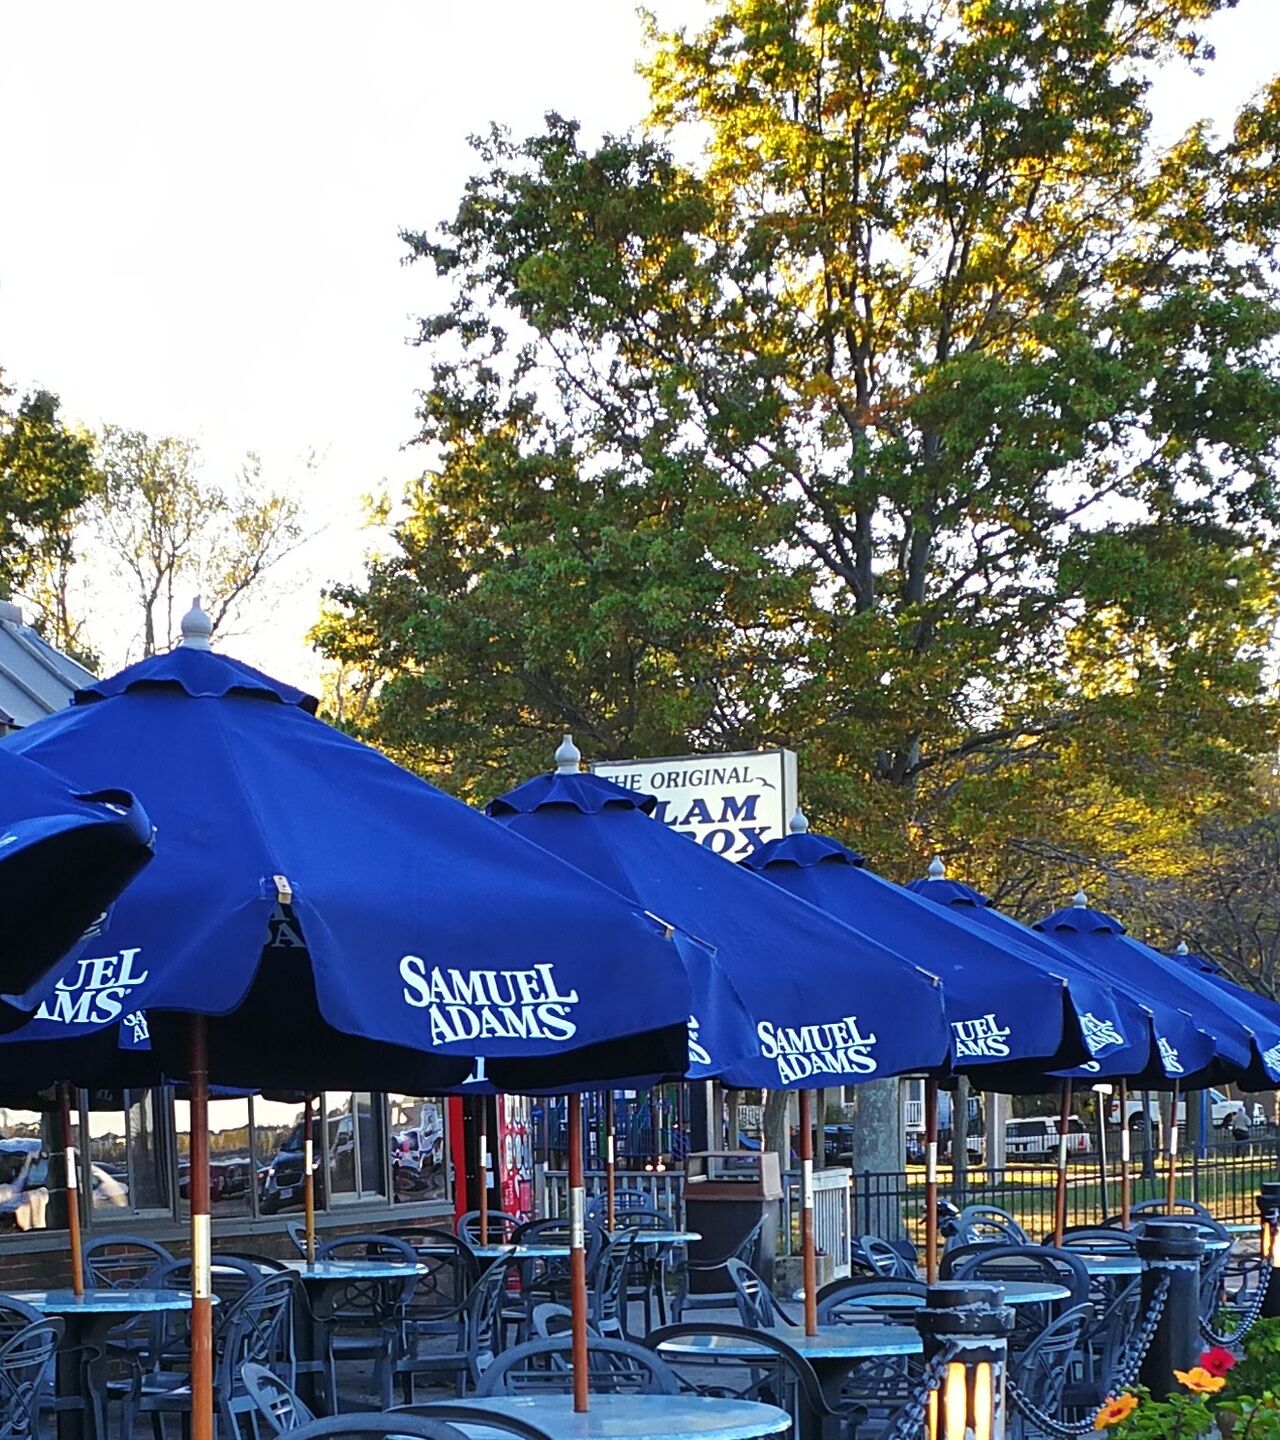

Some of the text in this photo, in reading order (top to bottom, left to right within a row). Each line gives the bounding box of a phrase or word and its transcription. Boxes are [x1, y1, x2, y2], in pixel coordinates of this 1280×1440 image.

[608, 766, 753, 790] HE ORIGINAL
[654, 794, 761, 826] LAM
[679, 826, 772, 855] OX
[399, 955, 579, 1008] SAMUEL
[428, 1003, 577, 1046] ADAMS
[757, 1016, 877, 1059] SAMUEL
[950, 1013, 1011, 1041] UEL
[955, 1035, 1010, 1058] AMS
[777, 1046, 877, 1085] ADAMS
